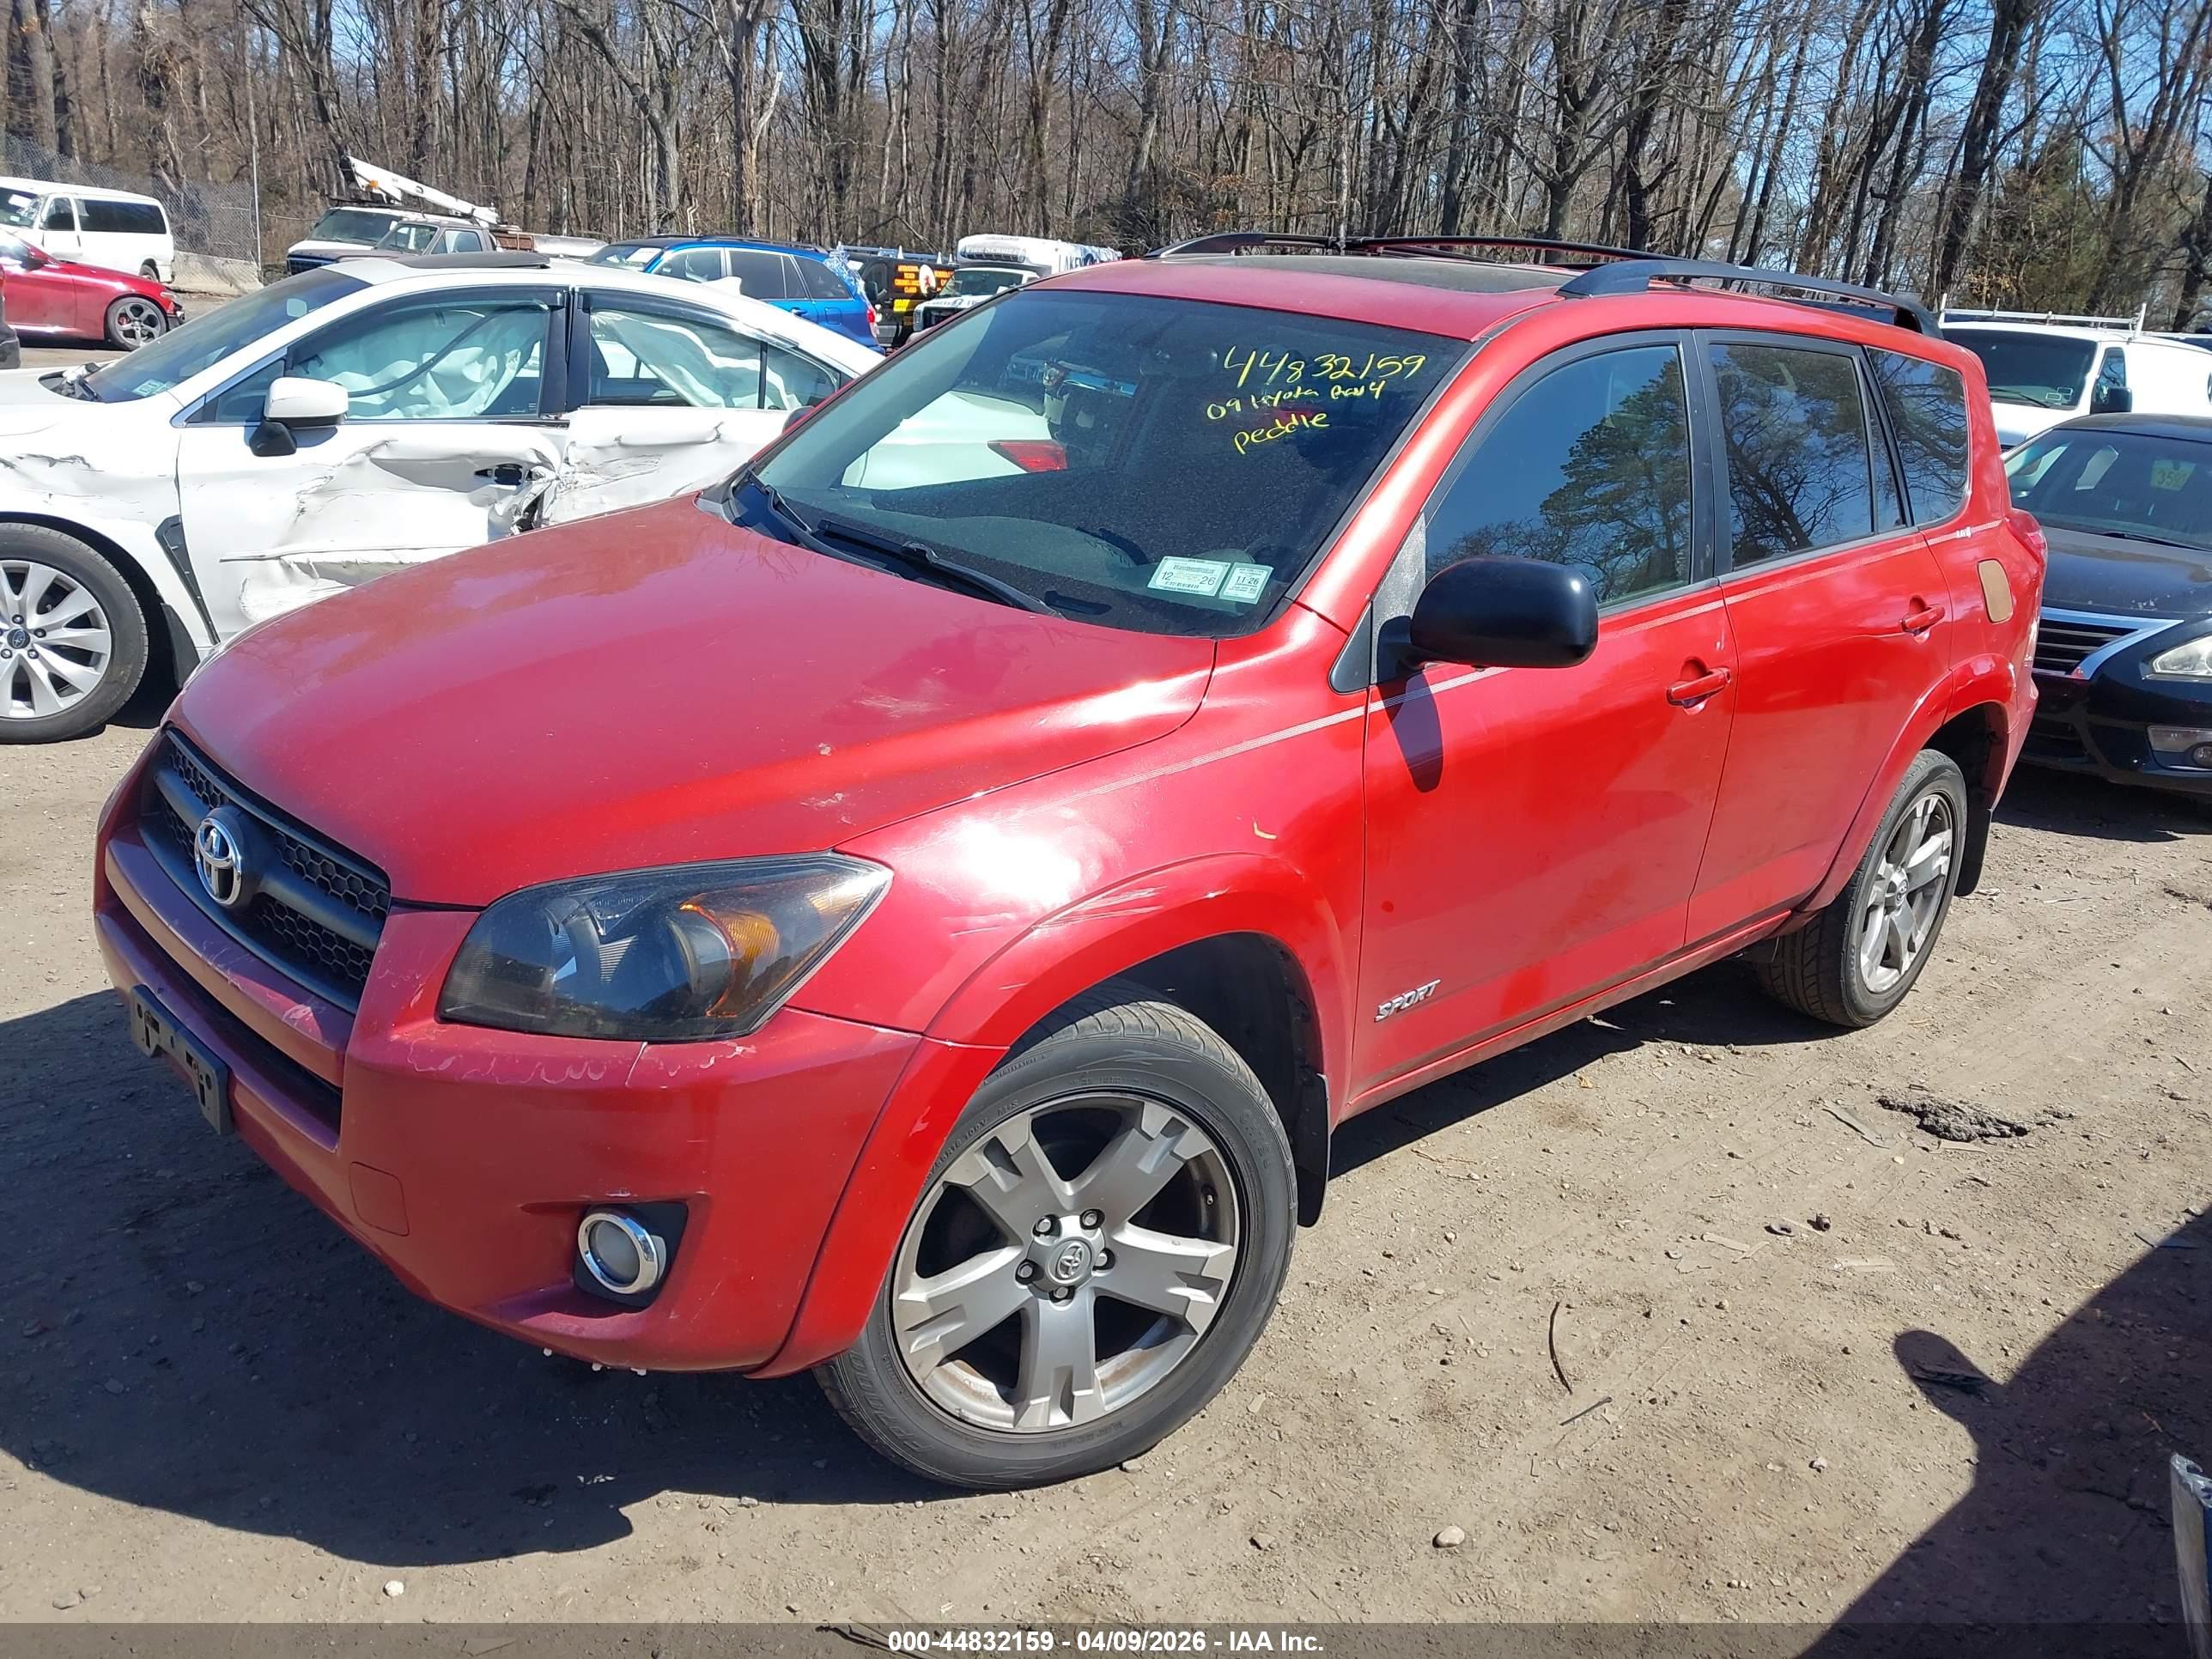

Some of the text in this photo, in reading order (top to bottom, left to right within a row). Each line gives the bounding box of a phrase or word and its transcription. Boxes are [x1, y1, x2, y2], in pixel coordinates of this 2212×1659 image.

[1224, 345, 1426, 387] 44832159
[1206, 398, 1242, 420] 09
[1234, 413, 1330, 455] peddle
[1161, 570, 1174, 581] 12
[1199, 575, 1217, 586] 26
[1374, 978, 1442, 1023] SPORT
